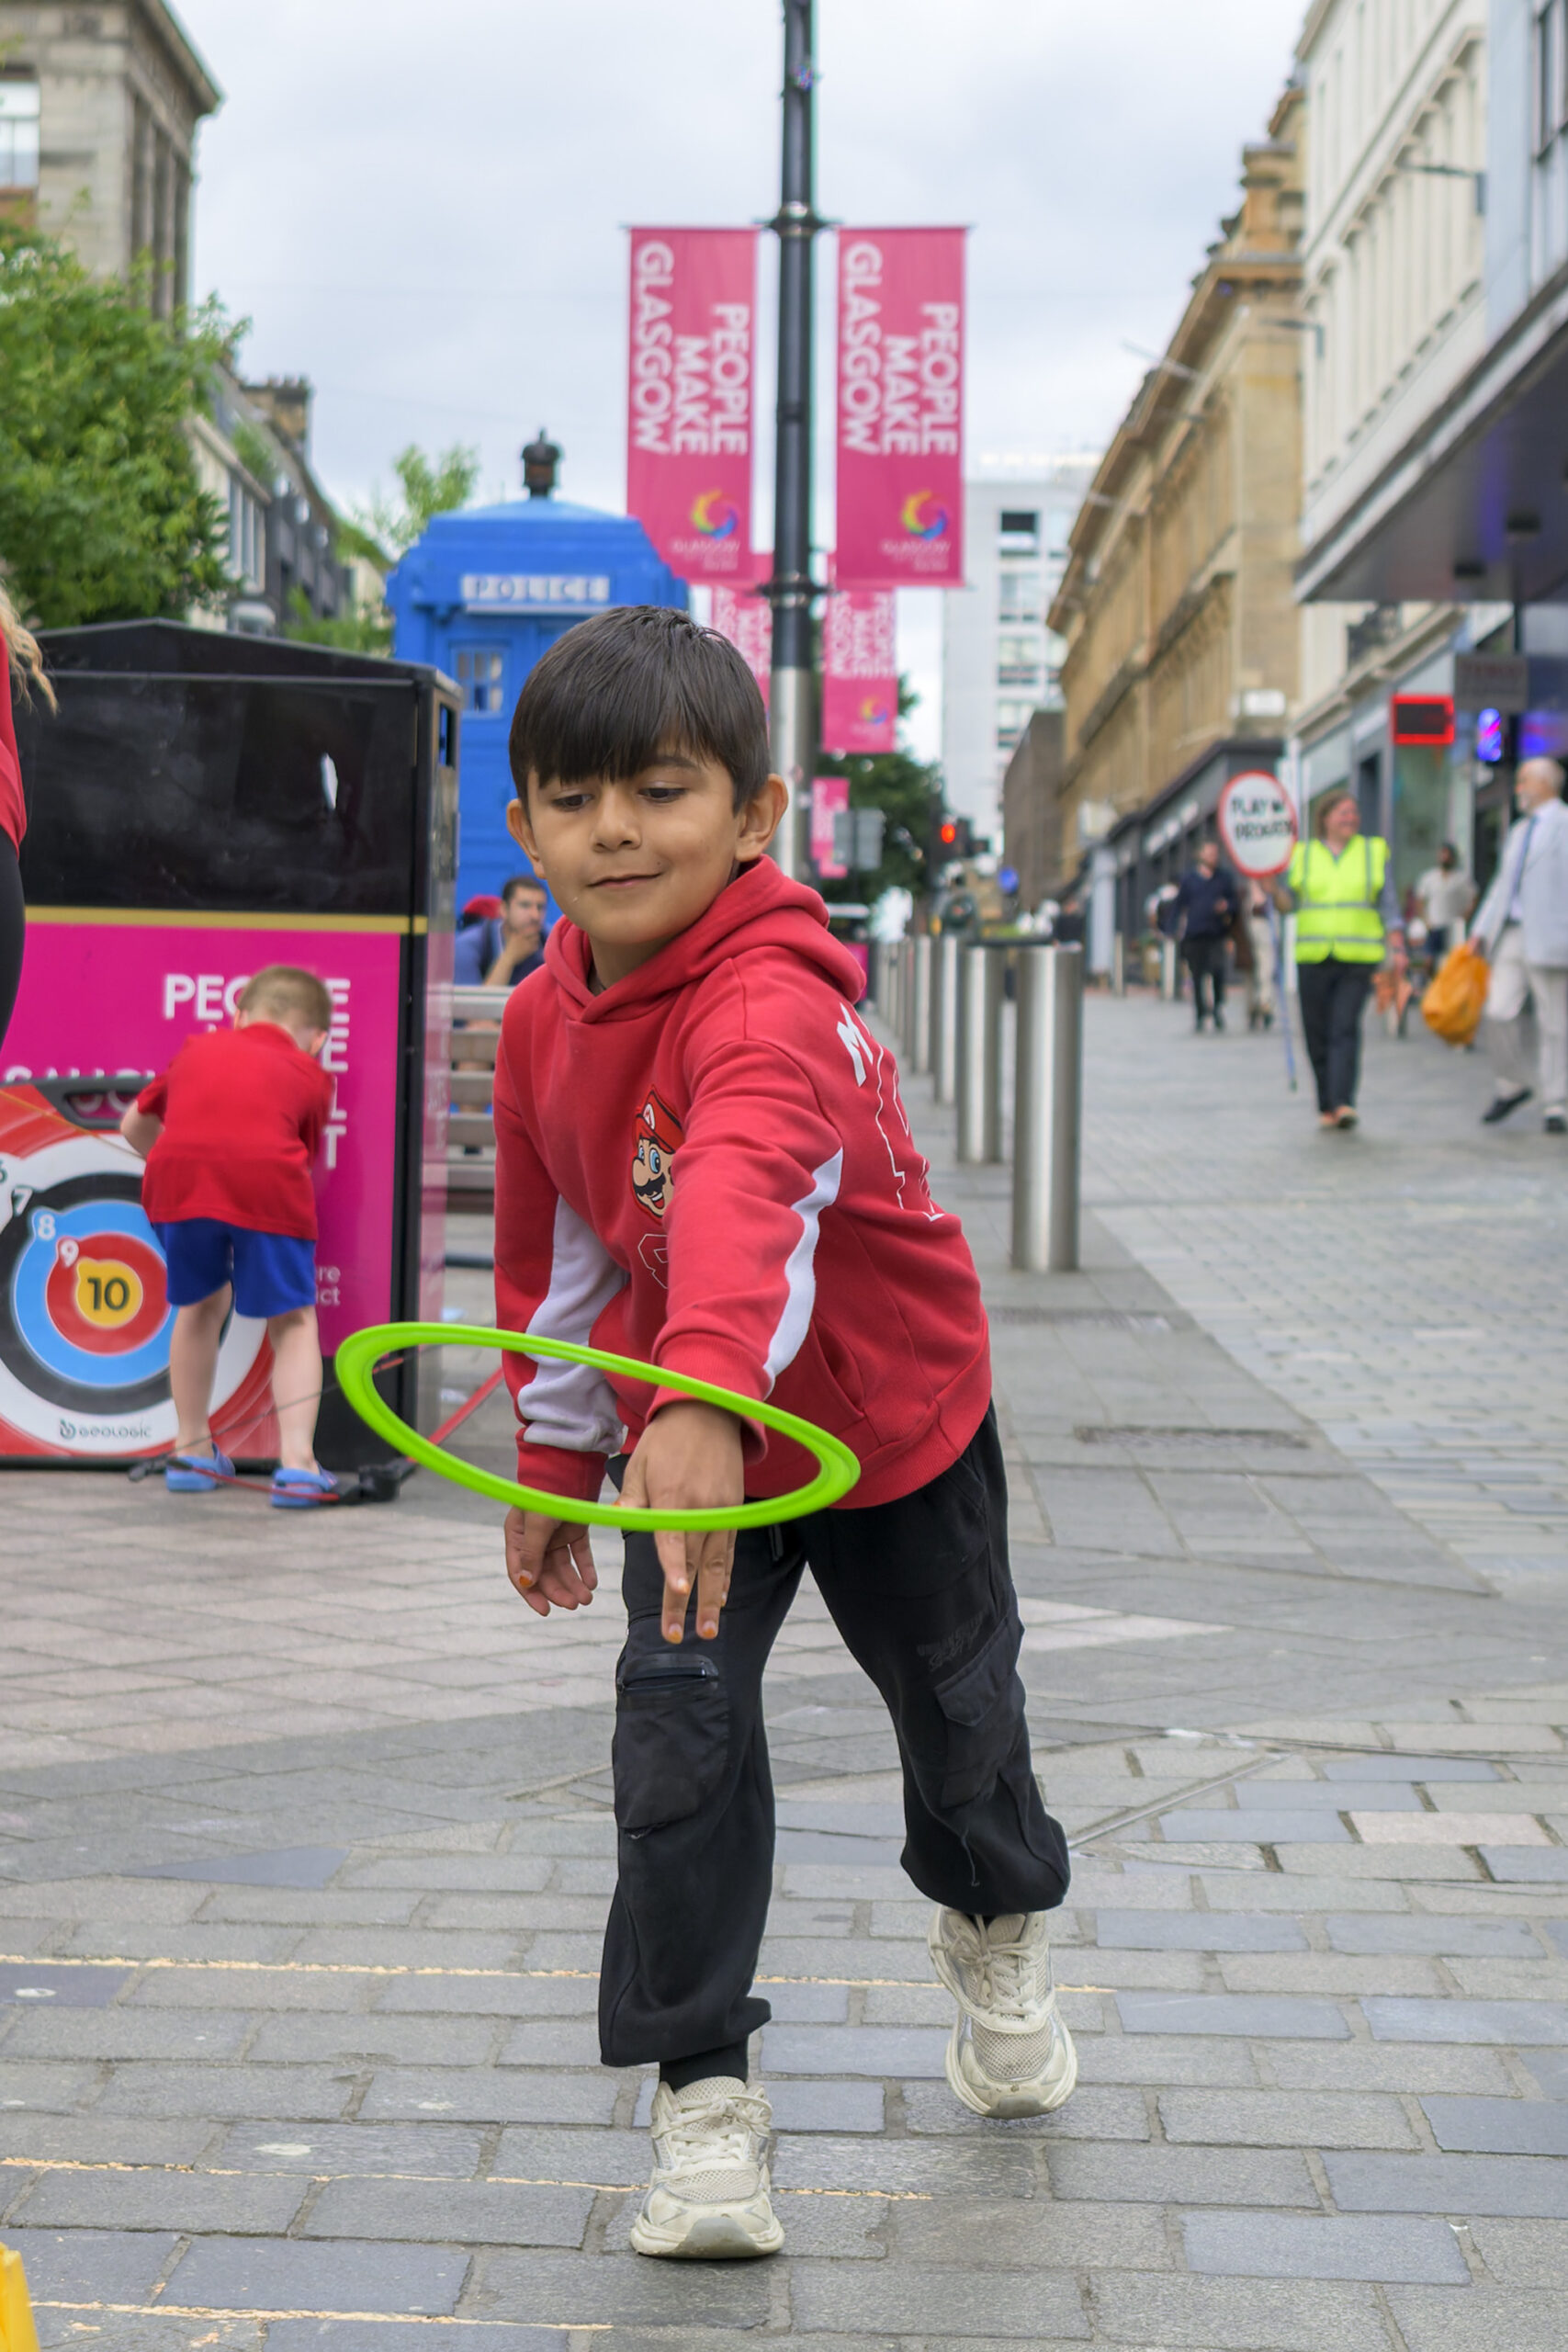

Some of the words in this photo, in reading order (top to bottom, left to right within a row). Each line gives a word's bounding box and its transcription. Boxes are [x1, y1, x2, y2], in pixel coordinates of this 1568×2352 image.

[636, 242, 674, 455] GLASGOW
[673, 334, 708, 455] MAKE
[712, 302, 750, 455] PEOPLE
[843, 242, 883, 455] GLASGOW
[883, 334, 918, 455] MAKE
[920, 301, 959, 455] PEOPLE
[37, 1213, 56, 1240] 8
[60, 1238, 80, 1269] 9
[86, 1276, 130, 1312] 10
